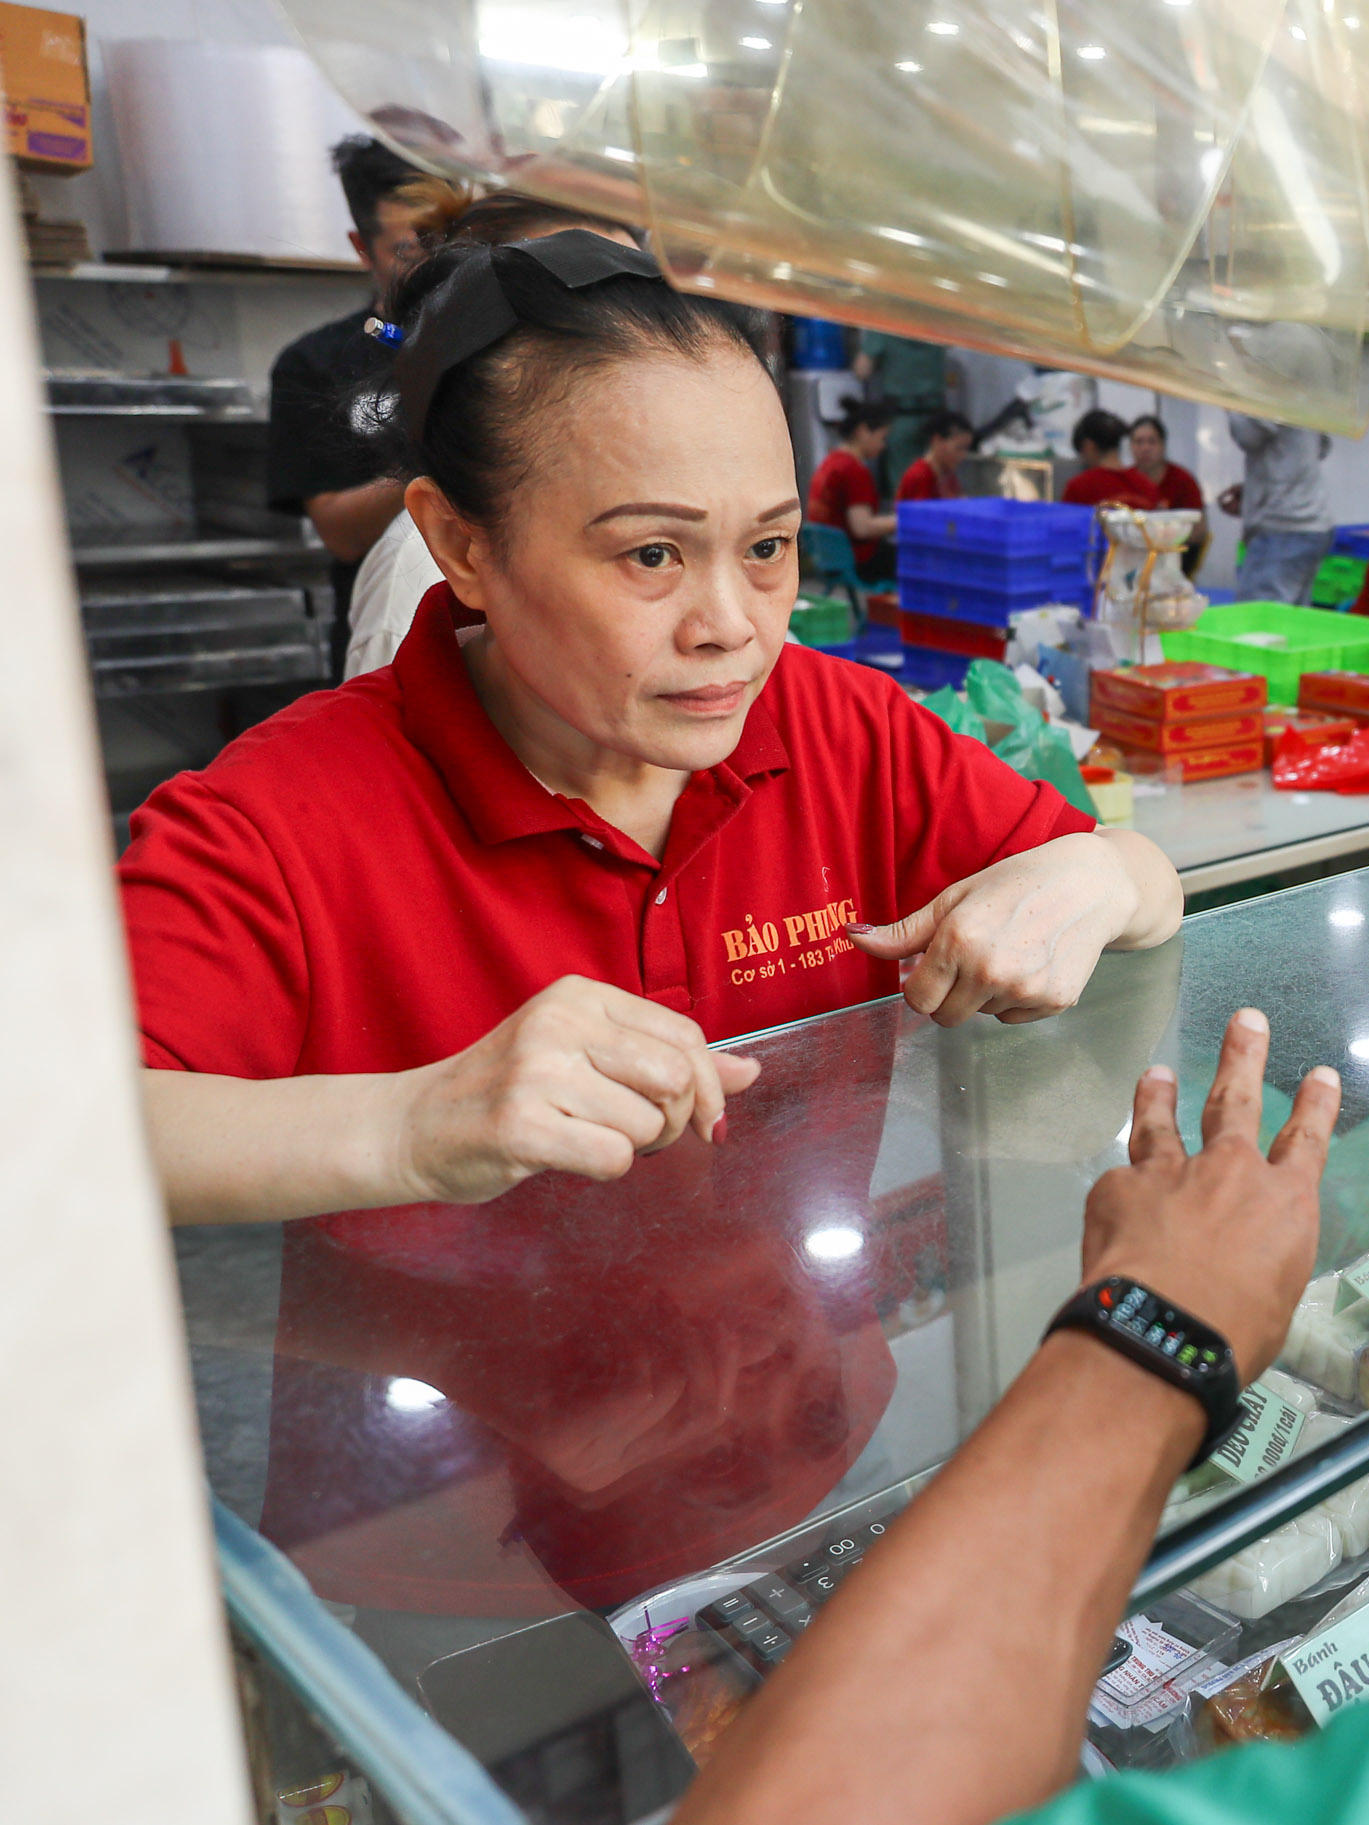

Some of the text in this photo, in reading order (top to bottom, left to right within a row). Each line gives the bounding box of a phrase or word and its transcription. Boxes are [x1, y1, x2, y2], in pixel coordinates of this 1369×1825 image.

[721, 914, 780, 963] BẢO
[731, 968, 756, 986] Cơ
[759, 960, 776, 979] sở
[778, 958, 787, 975] 1
[798, 949, 825, 970] 183
[1292, 1641, 1338, 1676] Bánh
